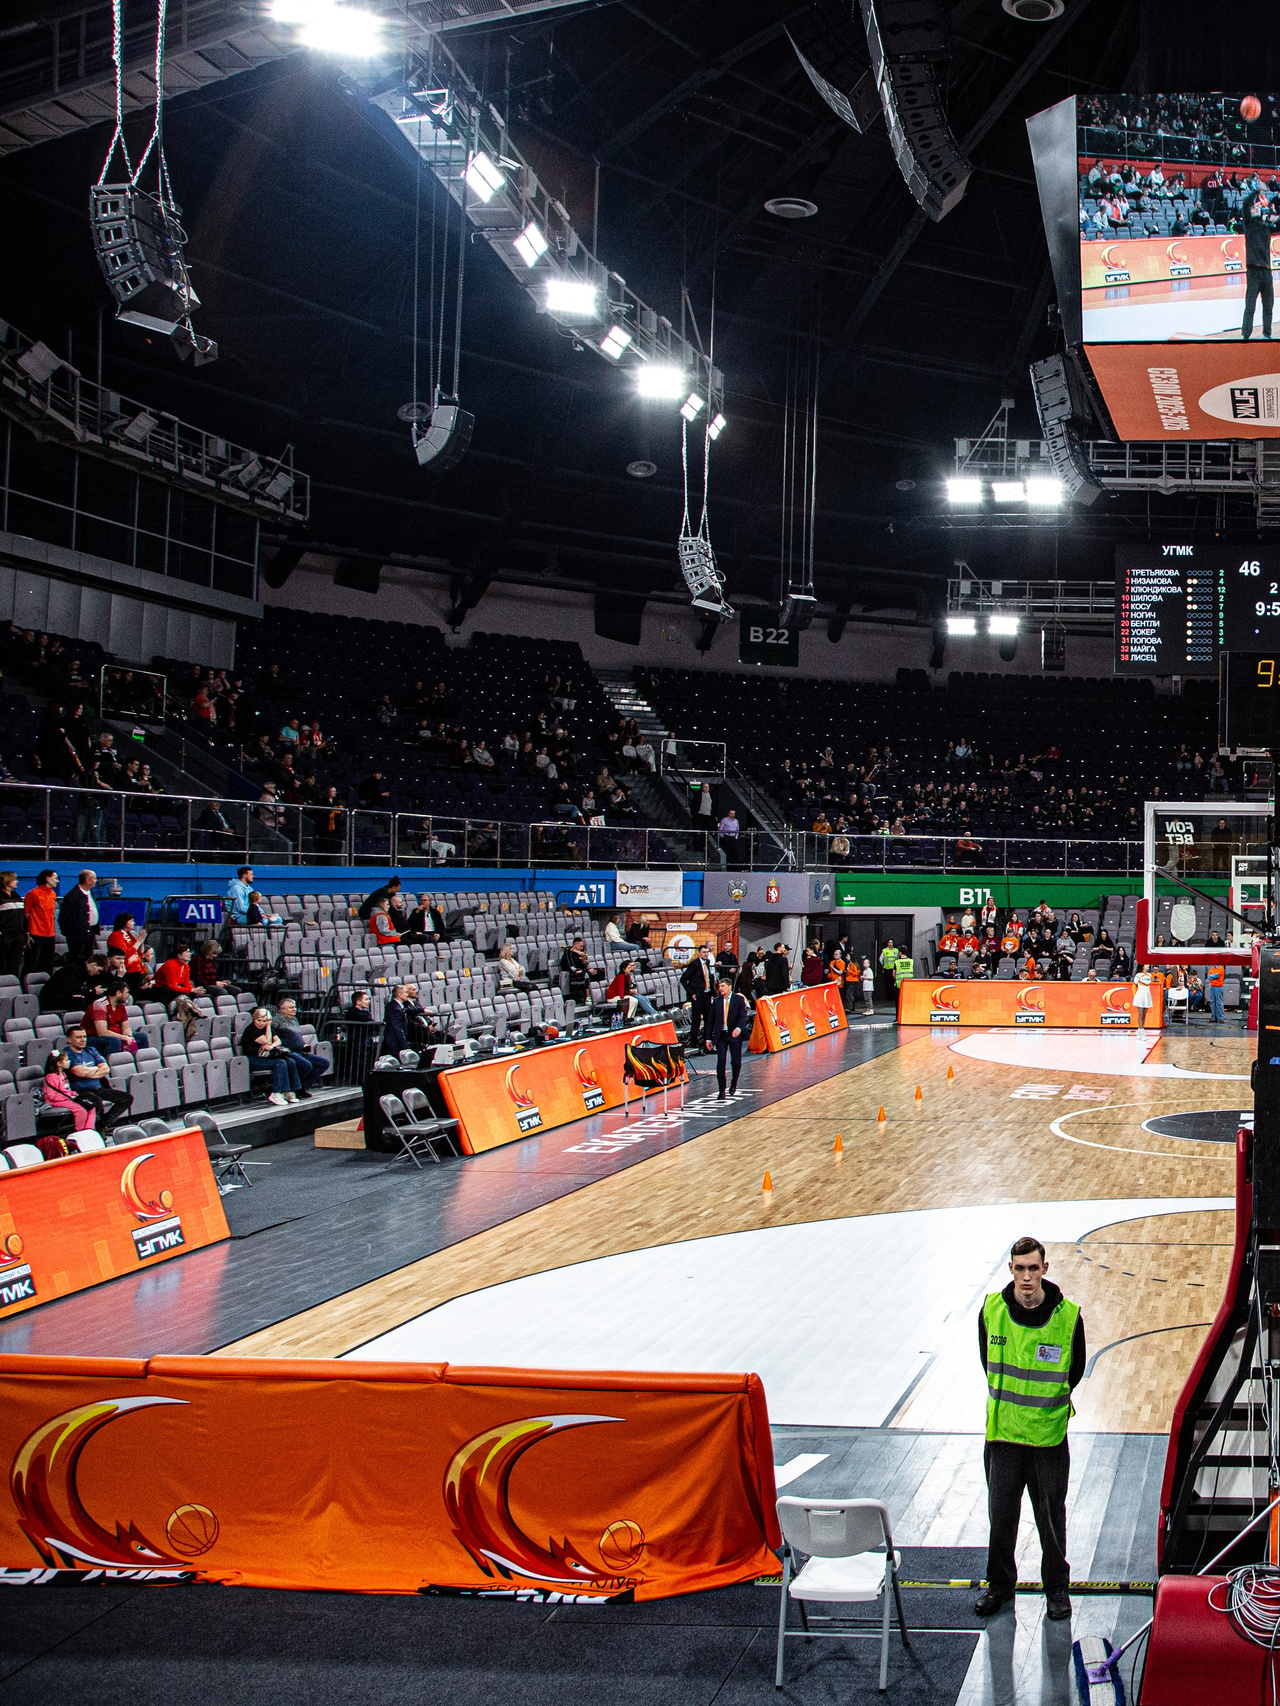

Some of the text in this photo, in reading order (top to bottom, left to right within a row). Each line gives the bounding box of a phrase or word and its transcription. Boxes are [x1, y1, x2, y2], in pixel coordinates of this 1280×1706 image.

[1147, 368, 1190, 431] СЕЗОН 2025-2026
[1234, 389, 1257, 418] УГМК
[1162, 546, 1194, 556] УГМК
[1239, 562, 1261, 577] 46
[1270, 583, 1278, 594] 2
[1131, 645, 1156, 653] МАЙГА
[574, 884, 606, 904] A11
[960, 888, 991, 905] B11
[185, 904, 216, 920] A11
[521, 1116, 542, 1131] УГМК
[138, 1230, 184, 1258] УГМК
[0, 1278, 35, 1303] МК
